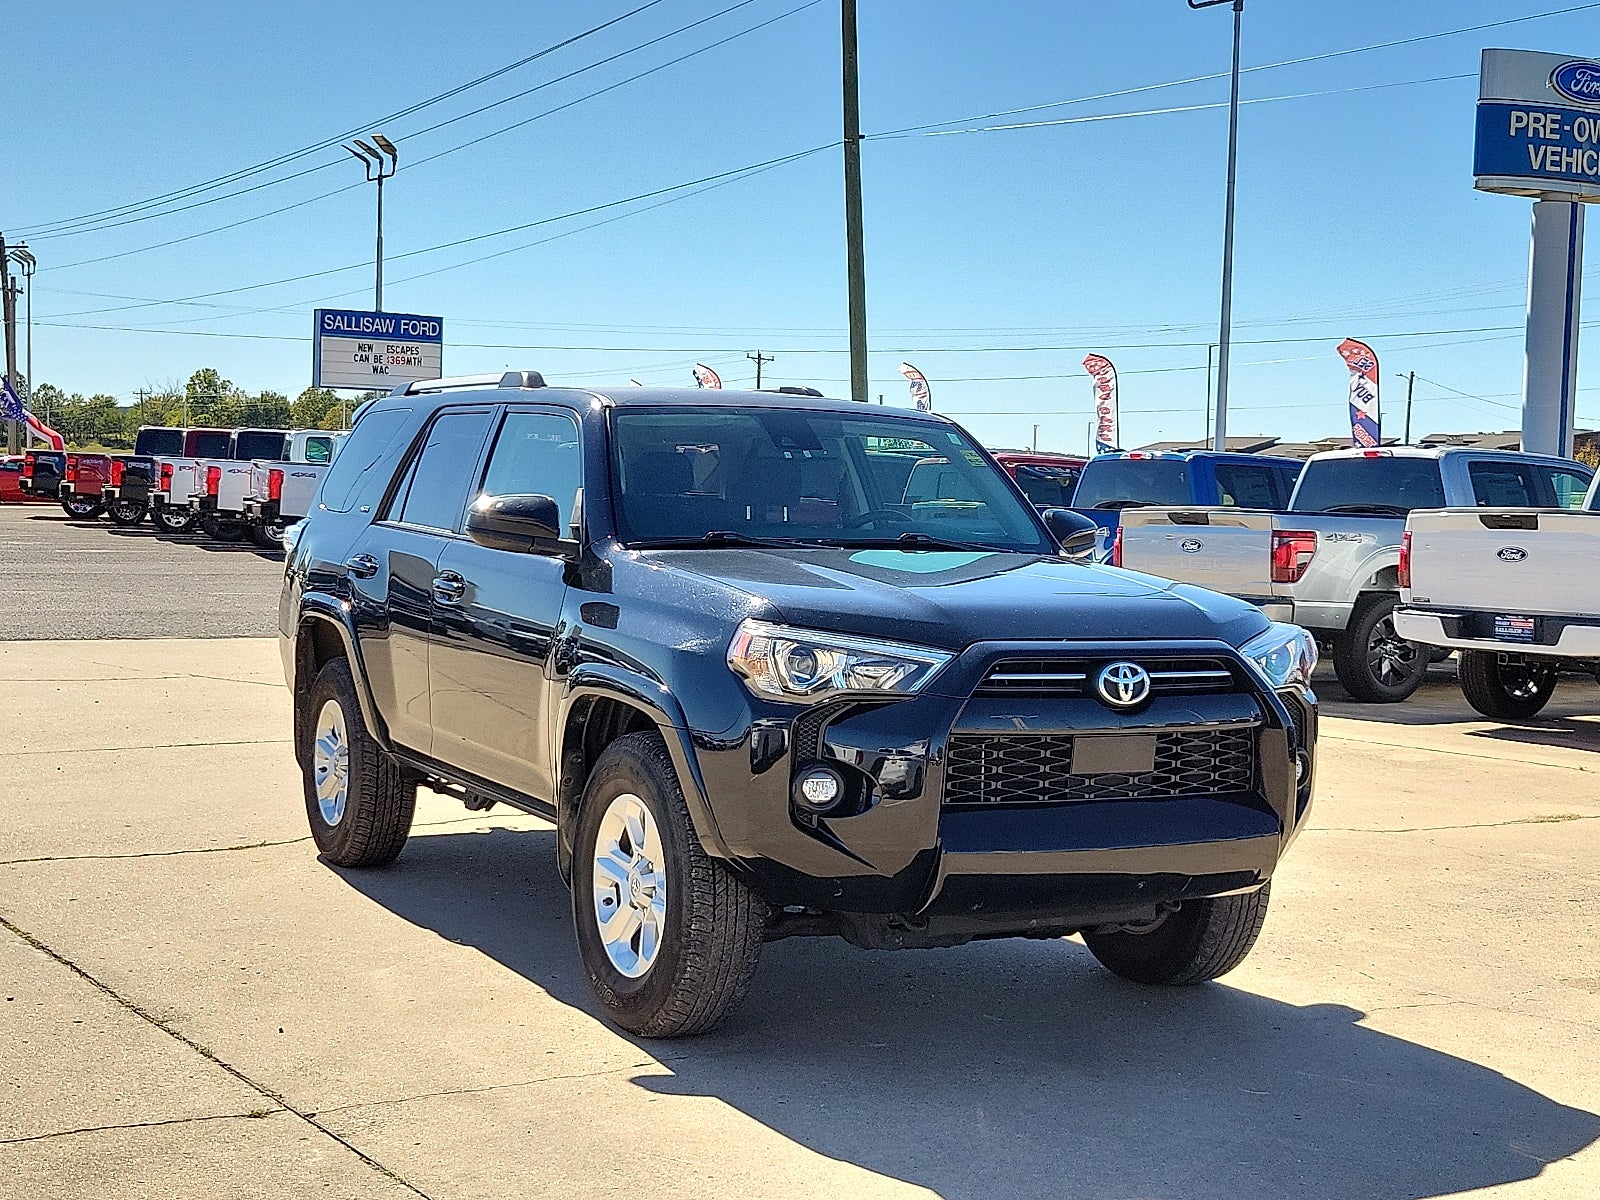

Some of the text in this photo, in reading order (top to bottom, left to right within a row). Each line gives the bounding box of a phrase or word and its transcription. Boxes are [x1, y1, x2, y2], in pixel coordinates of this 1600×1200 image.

[1571, 68, 1600, 94] For
[1527, 144, 1600, 176] VEHIC
[324, 314, 439, 336] SALLISAW FORD
[357, 343, 420, 355] NEW ESCAPES
[353, 353, 370, 364] CAN
[373, 355, 383, 364] BE
[372, 365, 390, 375] WAC
